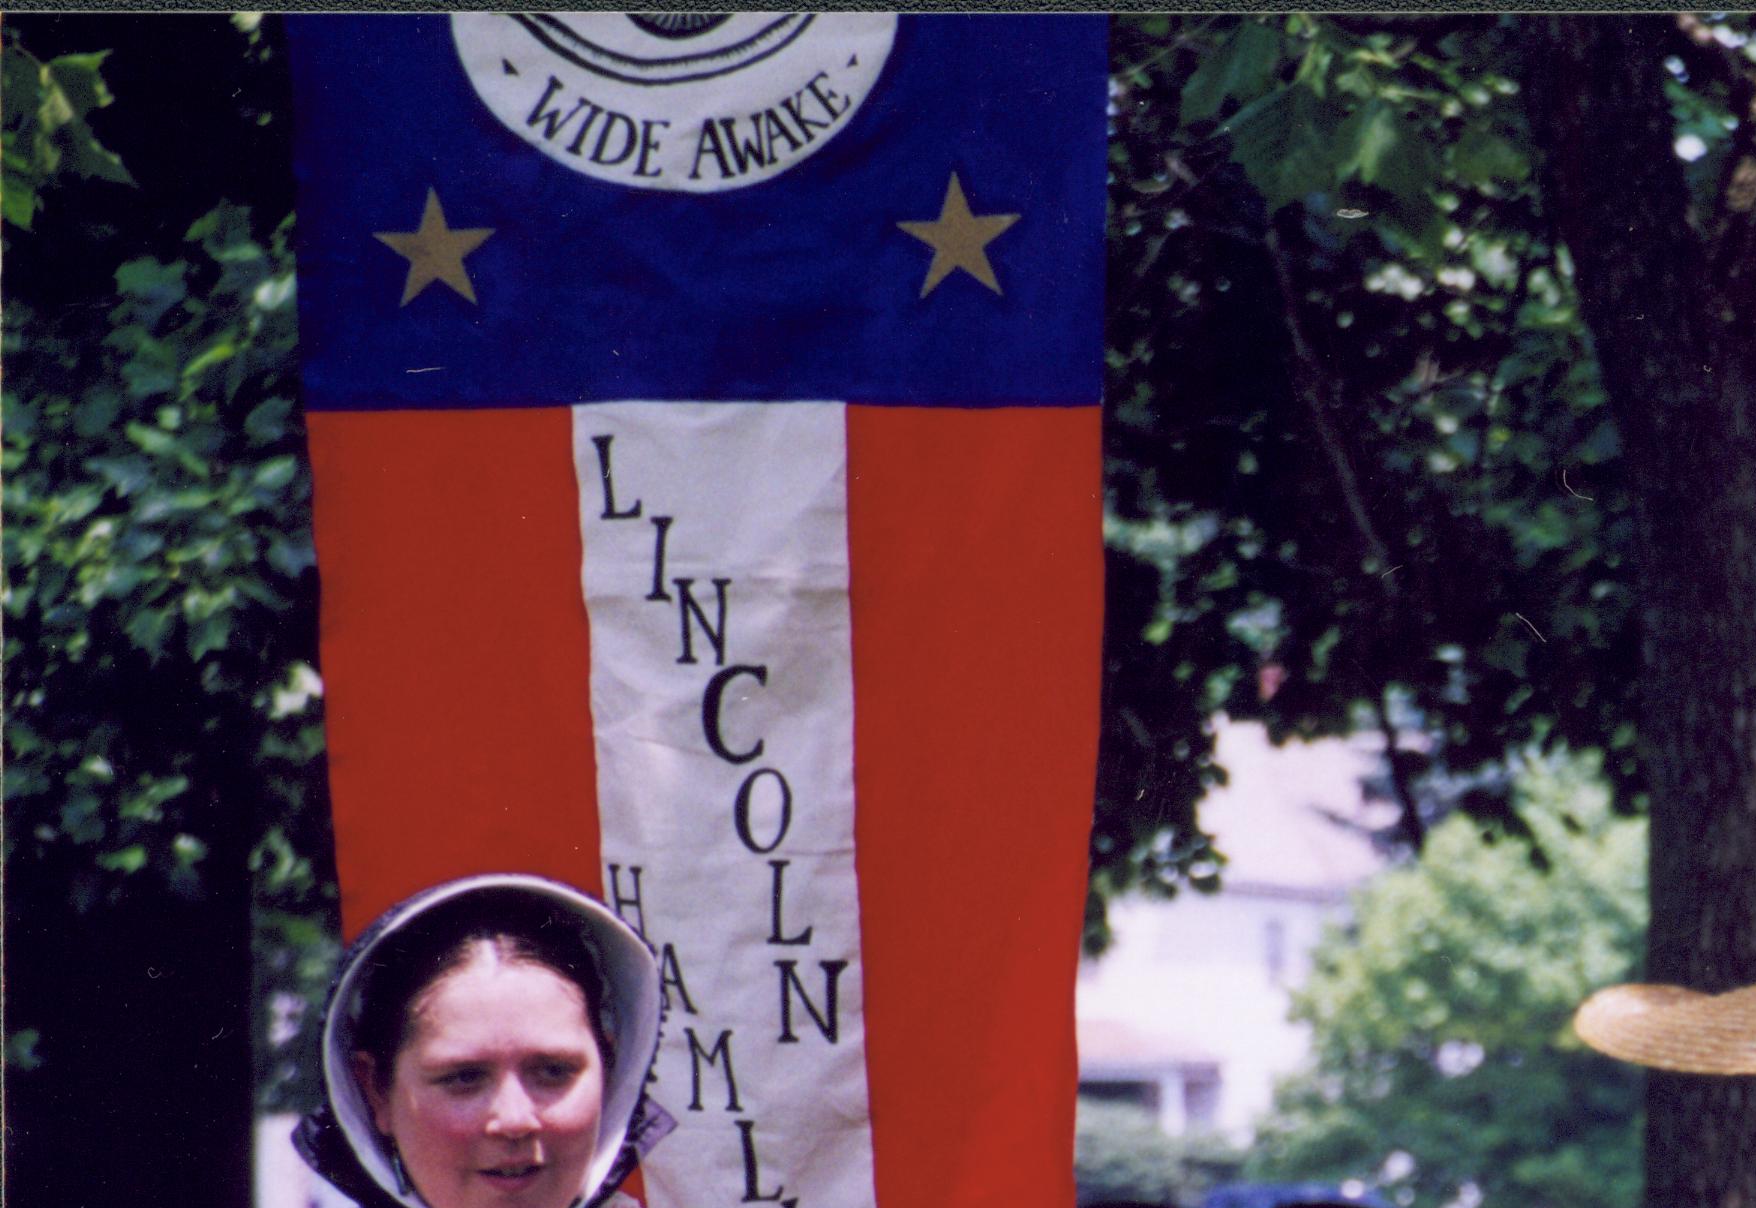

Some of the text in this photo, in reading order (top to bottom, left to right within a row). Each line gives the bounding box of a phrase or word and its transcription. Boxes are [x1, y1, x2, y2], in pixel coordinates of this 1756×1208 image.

[525, 71, 852, 180] WIDE AWAKE
[591, 434, 848, 1044] LINCOLN
